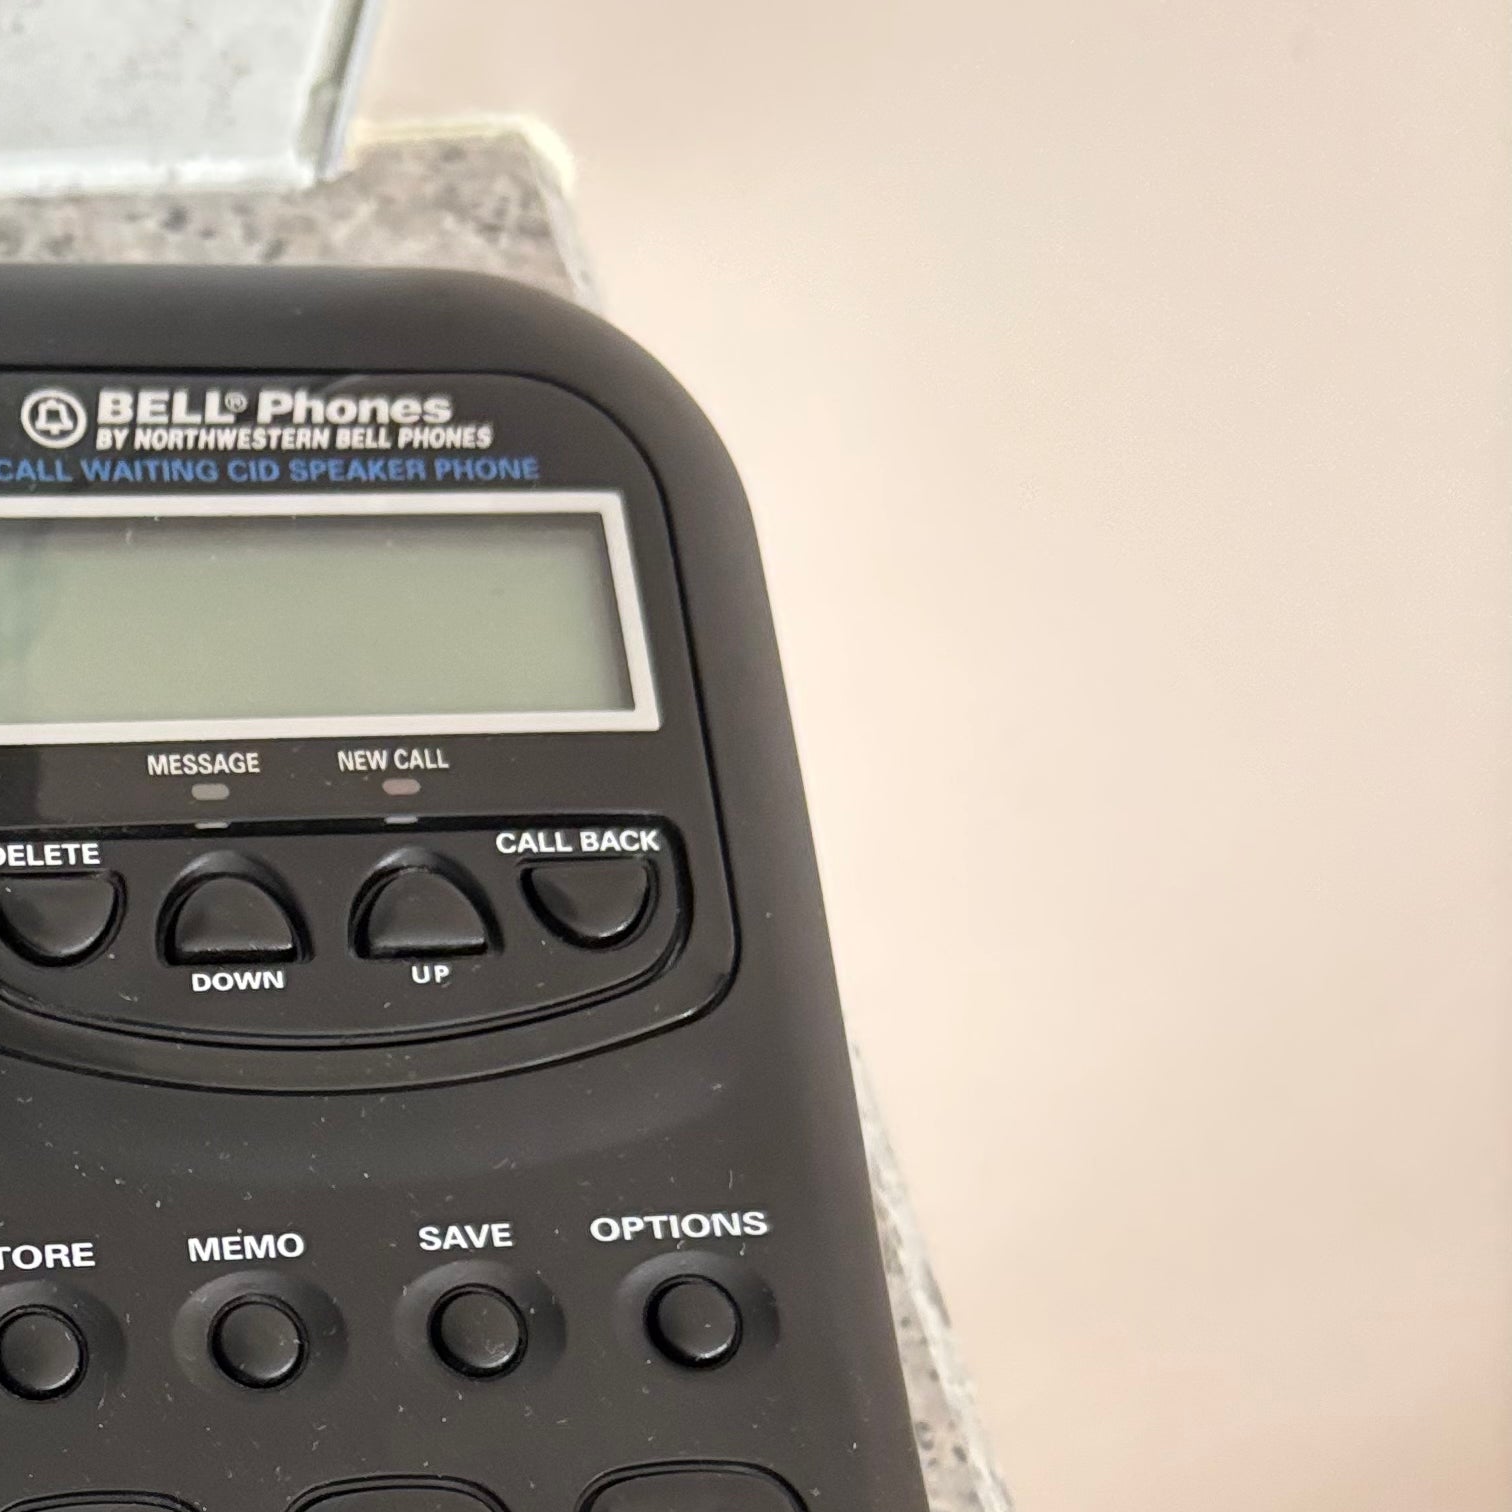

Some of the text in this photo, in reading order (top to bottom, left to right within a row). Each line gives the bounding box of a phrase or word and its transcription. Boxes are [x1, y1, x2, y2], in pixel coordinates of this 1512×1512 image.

[257, 390, 452, 424] Phones
[95, 423, 492, 450] BY NORTHWESTERN BELL PHONES
[80, 458, 219, 482] WAITING
[227, 458, 280, 482] CID
[288, 458, 427, 482] SPEAKER
[434, 457, 539, 480] PHONE
[147, 752, 261, 776] MESSAGE
[337, 748, 450, 771] NEW CALL
[495, 829, 660, 854] CALL BACK
[191, 970, 284, 992] DOWN
[411, 964, 450, 984] UP
[418, 1223, 513, 1251] SAVE
[589, 1211, 768, 1242] OPTIONS
[187, 1233, 305, 1262] MEMO
